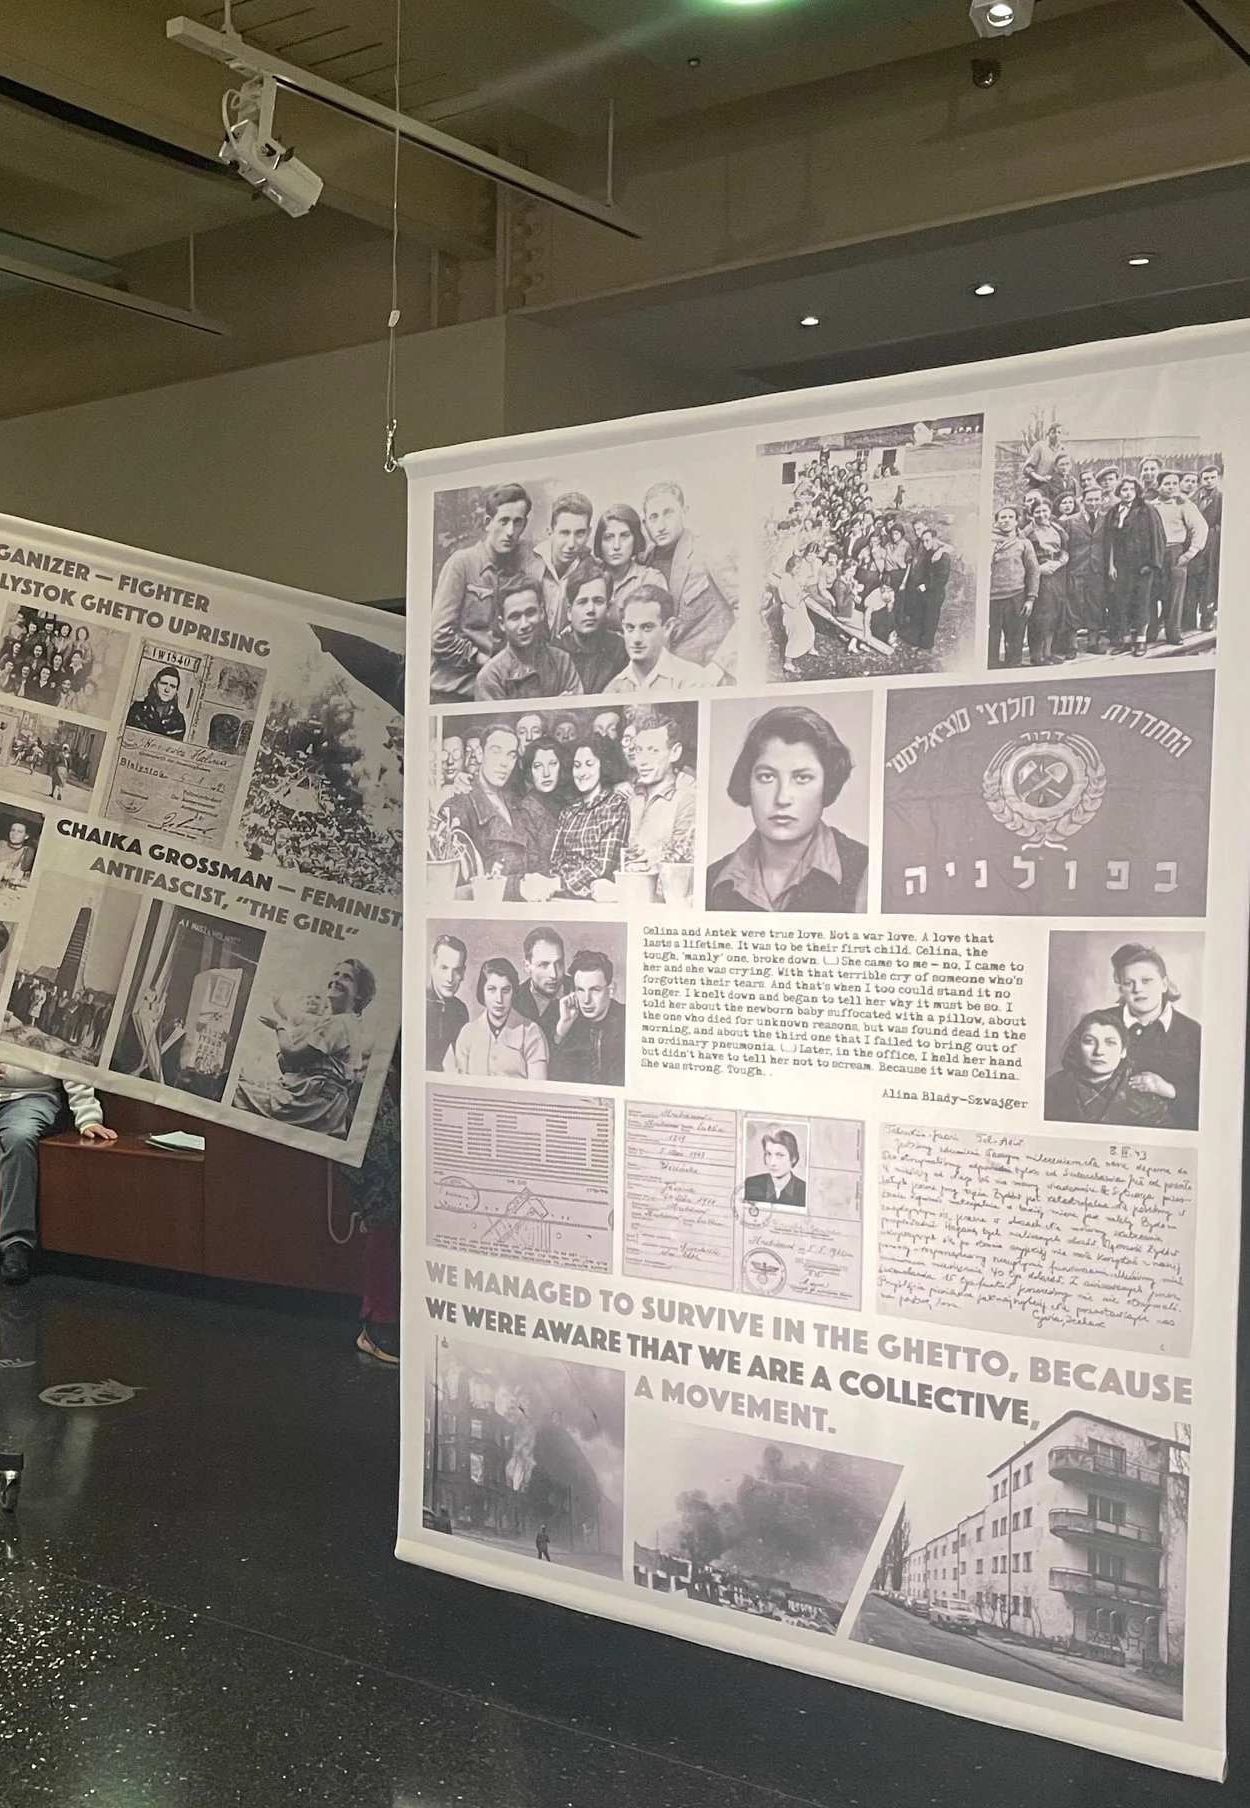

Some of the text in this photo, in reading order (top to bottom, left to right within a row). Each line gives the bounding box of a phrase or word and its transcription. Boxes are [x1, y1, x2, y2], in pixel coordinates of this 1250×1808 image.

[117, 574, 210, 613] FIGHTER
[80, 592, 164, 631] GHETTO
[168, 613, 273, 657] UPRISING
[976, 695, 1036, 726] חלוצי
[56, 818, 143, 858] CHAIKA
[148, 844, 274, 893] GROSSMAN
[89, 856, 230, 910] ANTIFASCIST,
[643, 926, 678, 936] Celina
[681, 928, 701, 937] and
[705, 928, 737, 938] Antek
[741, 930, 766, 938] were
[769, 929, 794, 939] true
[829, 930, 849, 940] Not
[863, 933, 884, 941] war
[922, 933, 929, 942] A
[933, 933, 961, 943] love
[965, 933, 994, 944] that
[643, 939, 672, 948] lasts
[737, 941, 749, 950] It
[752, 943, 771, 951] was
[775, 941, 787, 951] to
[790, 941, 803, 952] be
[806, 942, 838, 952] their
[841, 944, 872, 954] first
[966, 947, 988, 957] the
[643, 963, 662, 972] her
[664, 964, 683, 973] and
[685, 964, 704, 973] she
[707, 966, 726, 974] was
[777, 967, 803, 977] With
[808, 968, 833, 978] that
[838, 969, 887, 980] terrible
[890, 973, 911, 983] cry
[915, 972, 929, 982] of
[932, 975, 985, 984] someone
[989, 975, 1023, 985] who's
[753, 954, 784, 964] broke
[841, 956, 862, 967] She
[864, 959, 892, 968] came
[896, 959, 909, 968] to
[913, 960, 928, 969] me
[964, 961, 971, 970] I
[975, 962, 1006, 971] came
[1010, 962, 1024, 972] to
[643, 975, 696, 986] forgotten
[700, 977, 730, 986] their
[771, 980, 791, 990] And
[795, 980, 830, 991] that's
[833, 982, 861, 992] when
[865, 984, 872, 993] I
[874, 984, 895, 994] too
[899, 985, 933, 995] could
[937, 986, 973, 997] stand
[977, 988, 991, 998] it
[994, 990, 1010, 999] no
[882, 1089, 1028, 1110] Alina Blady-Szwajger
[425, 1260, 1192, 1405] WE MANAGED TO SURVIVE IN THE GHETTO, BECAUSE
[425, 1296, 1040, 1431] WE WERE AWARE THAT WE ARE A COLLECTIVE,
[634, 1374, 837, 1435] A MOVEMENT.
